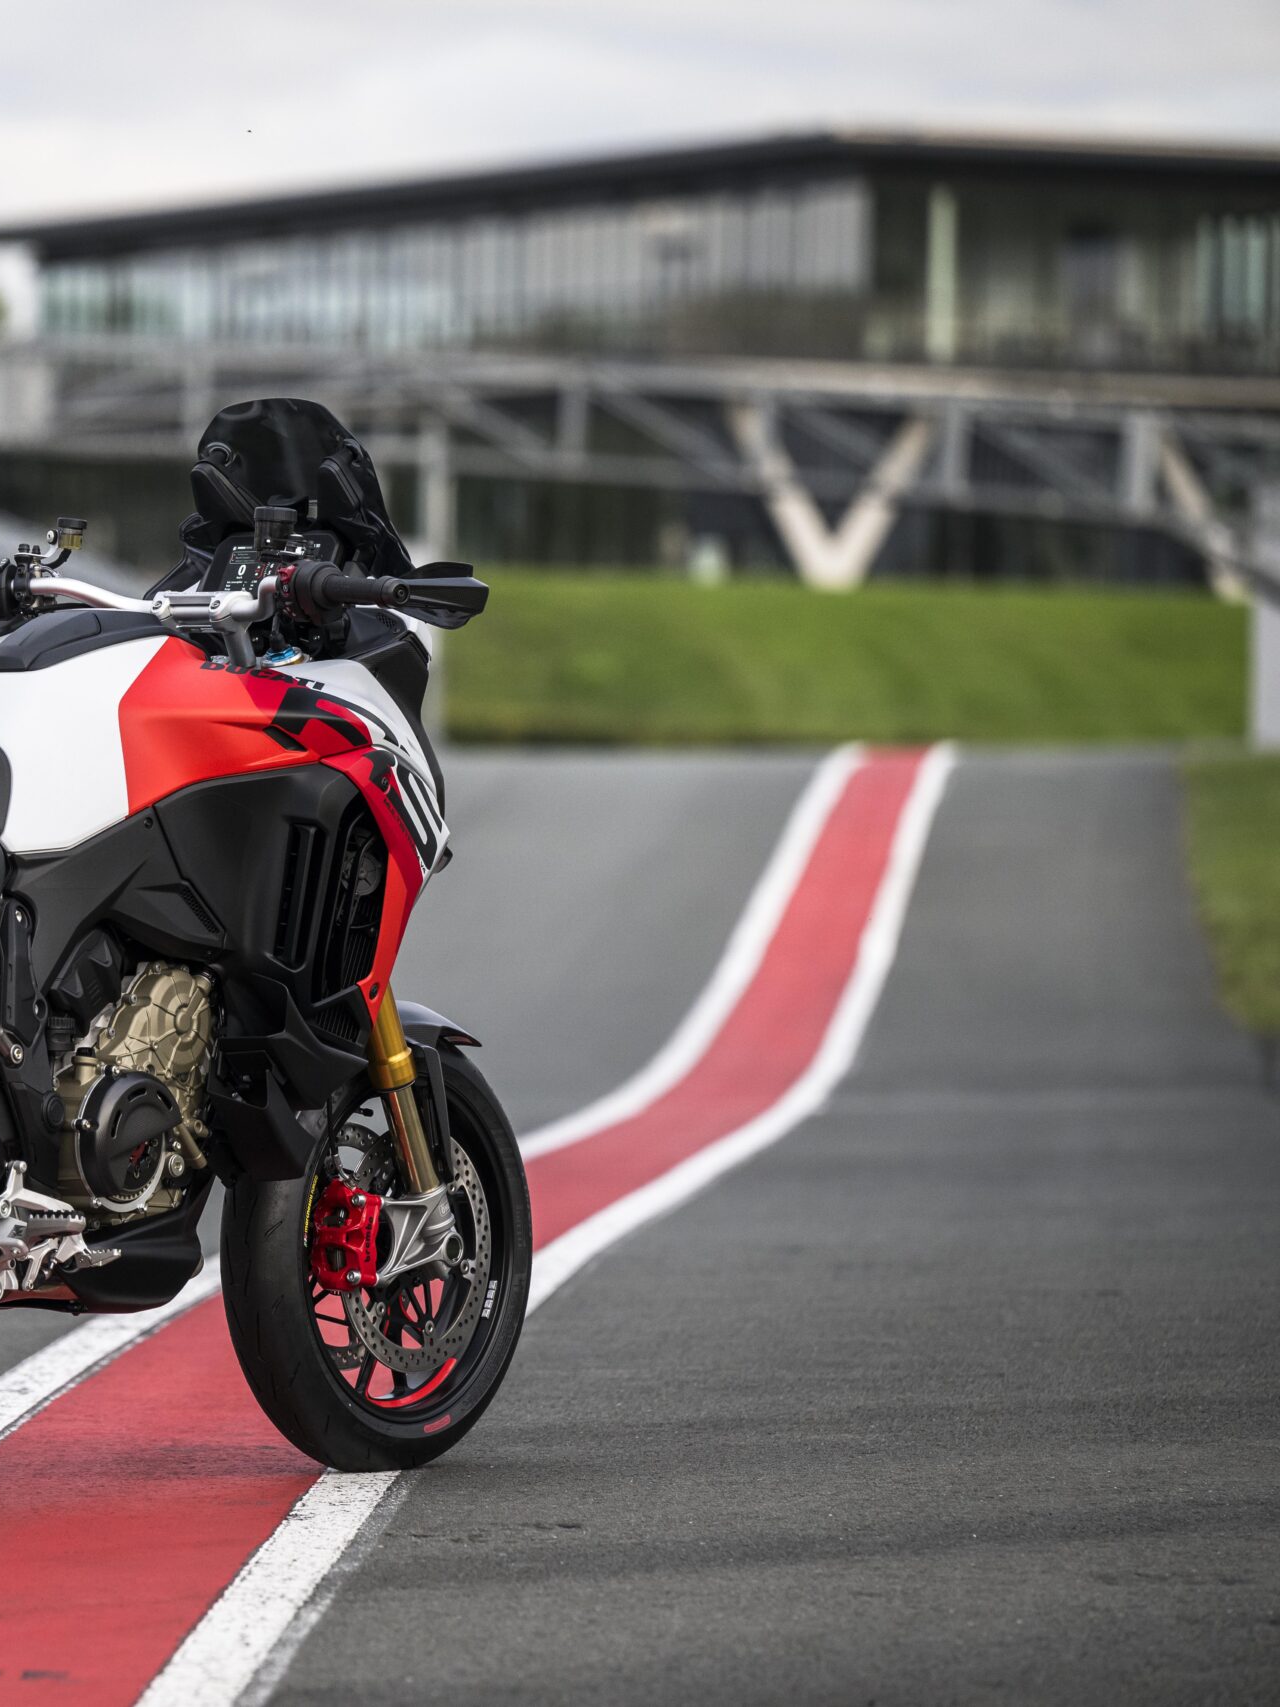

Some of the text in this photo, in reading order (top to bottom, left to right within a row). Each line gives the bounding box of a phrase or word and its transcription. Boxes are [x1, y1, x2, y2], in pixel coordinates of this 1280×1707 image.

[237, 564, 247, 576] 0
[200, 661, 324, 690] DUCATI
[365, 1217, 374, 1263] brembo
